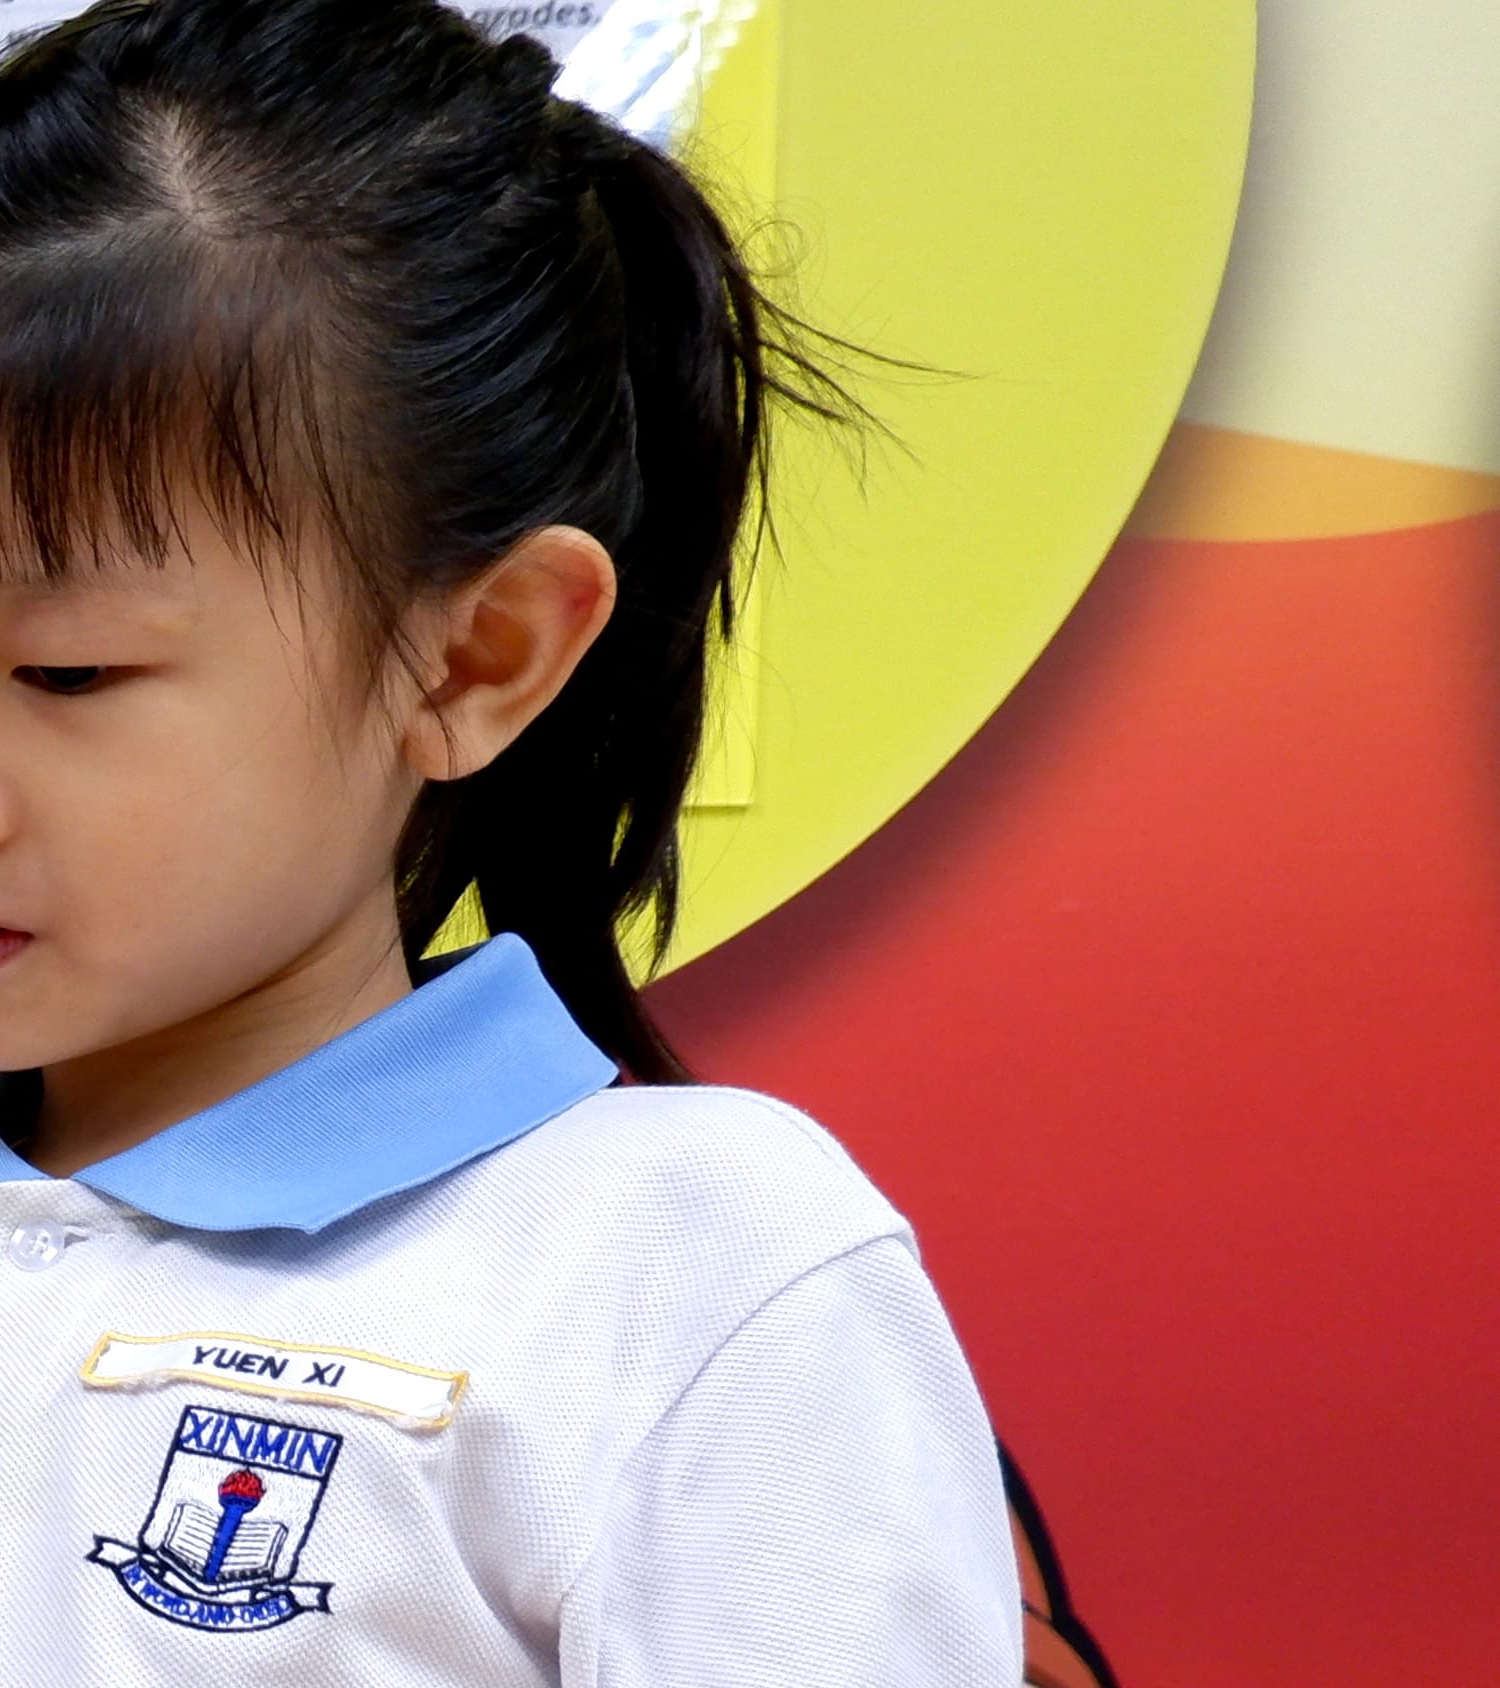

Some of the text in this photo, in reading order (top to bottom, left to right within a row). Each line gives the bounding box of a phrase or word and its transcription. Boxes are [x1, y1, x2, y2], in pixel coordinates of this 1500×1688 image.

[191, 1345, 347, 1388] YUEN XI
[180, 1412, 336, 1474] XINMIN
